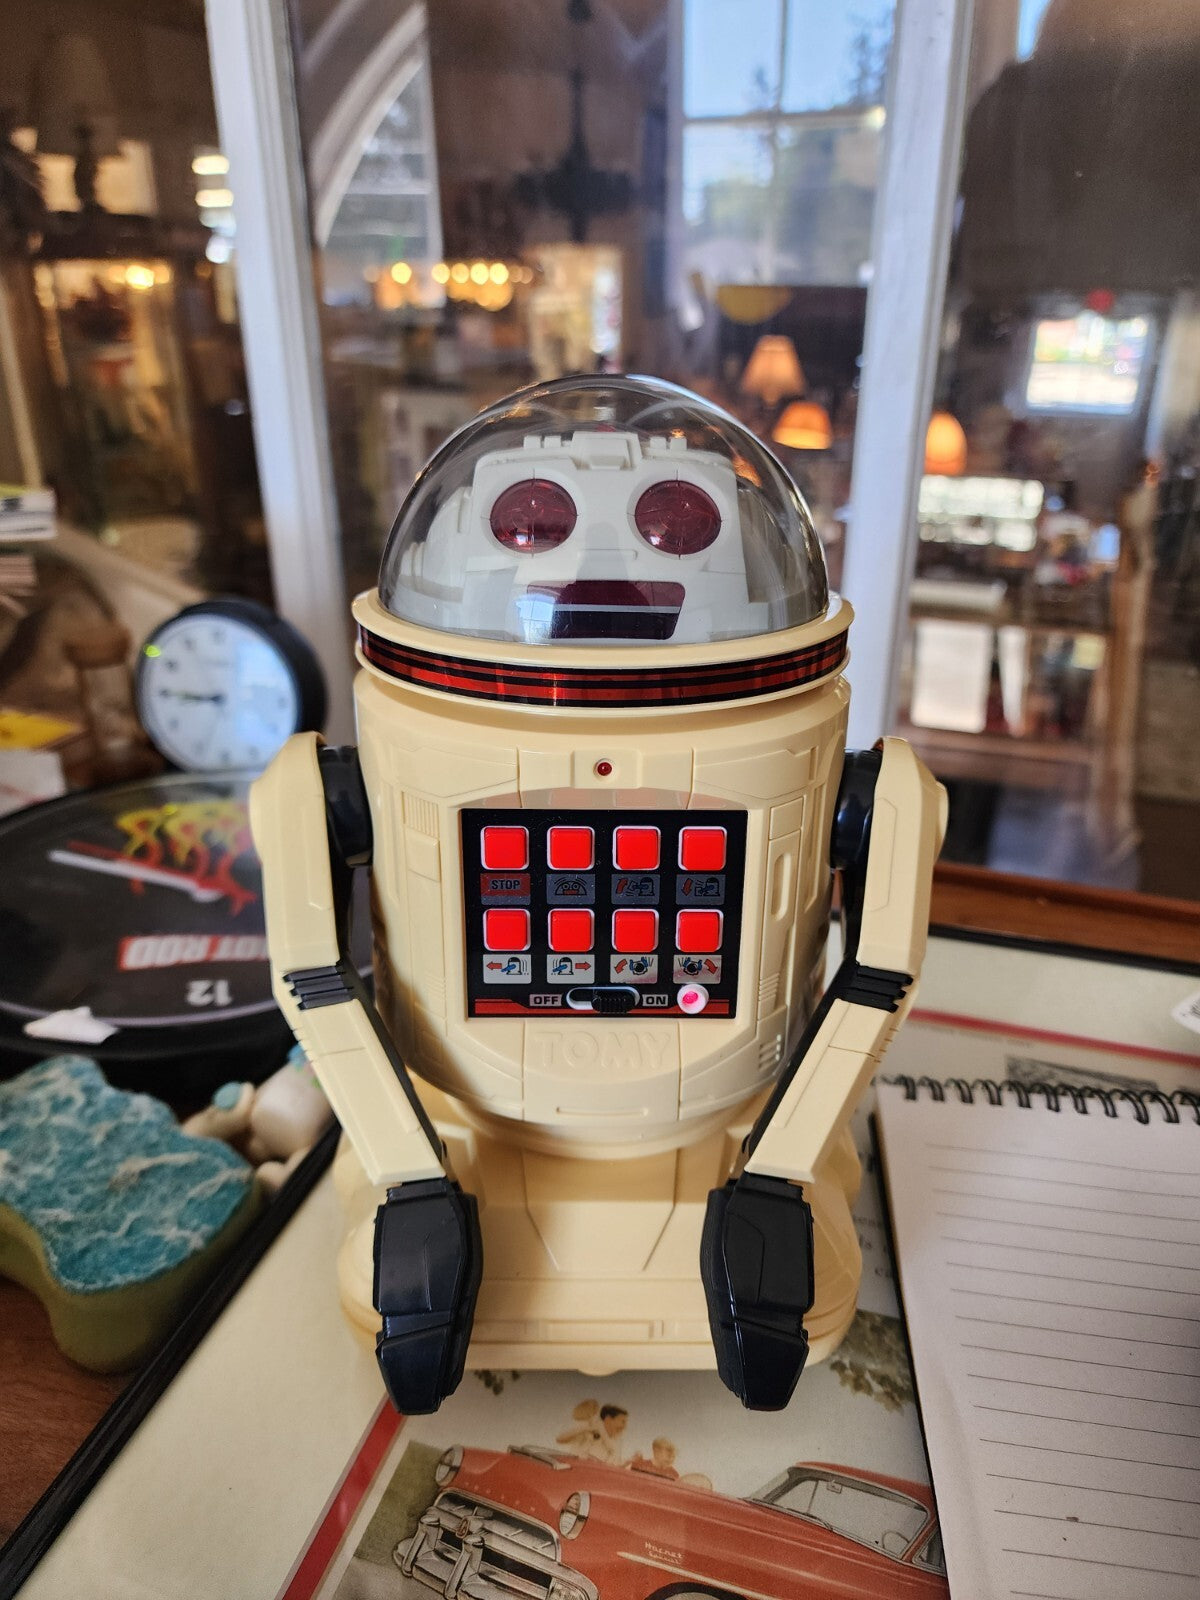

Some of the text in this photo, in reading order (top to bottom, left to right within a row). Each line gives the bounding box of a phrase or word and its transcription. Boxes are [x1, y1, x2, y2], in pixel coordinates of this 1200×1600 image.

[491, 879, 521, 890] STOP
[124, 935, 209, 970] ROD
[186, 978, 232, 1007] 12
[533, 995, 559, 1005] OFF
[645, 995, 667, 1005] ON
[534, 1030, 672, 1069] TOMY
